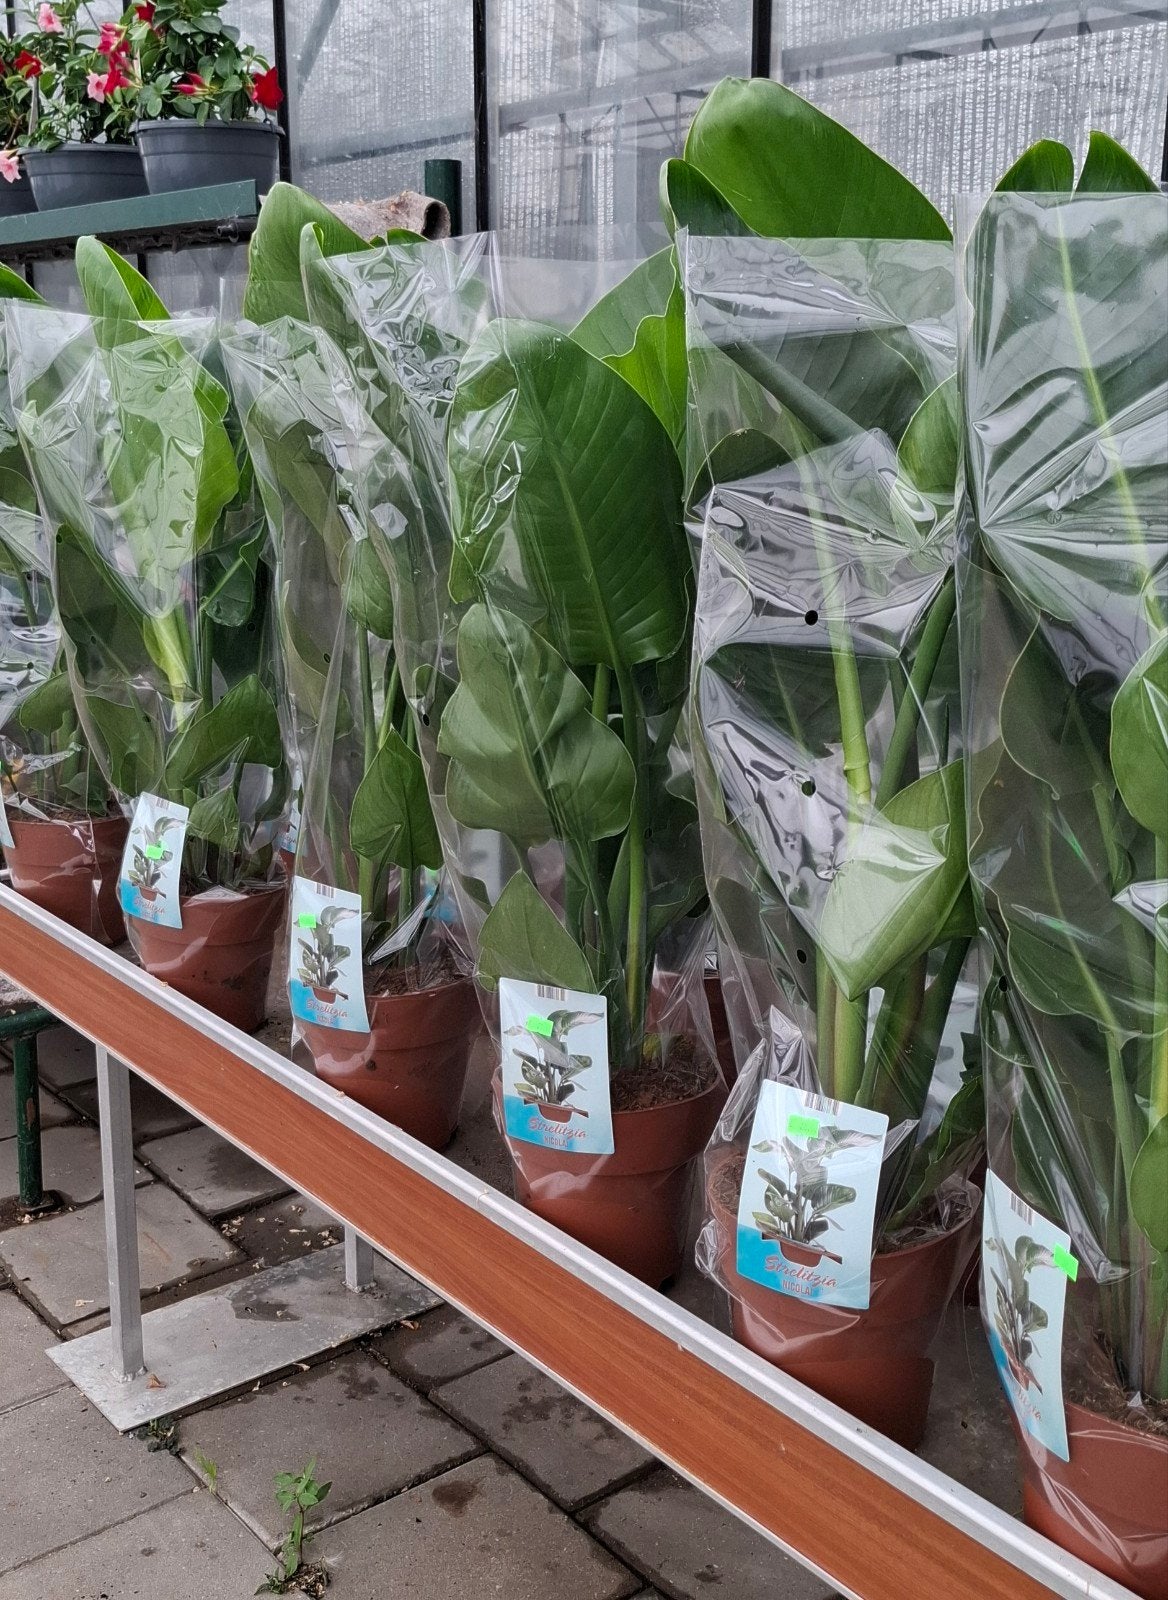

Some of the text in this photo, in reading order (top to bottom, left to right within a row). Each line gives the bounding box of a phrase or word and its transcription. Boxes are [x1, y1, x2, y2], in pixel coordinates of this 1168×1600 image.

[306, 999, 348, 1018] Strelitzia
[528, 1118, 586, 1139] Strelitzia
[764, 1255, 837, 1287] Strelitzia
